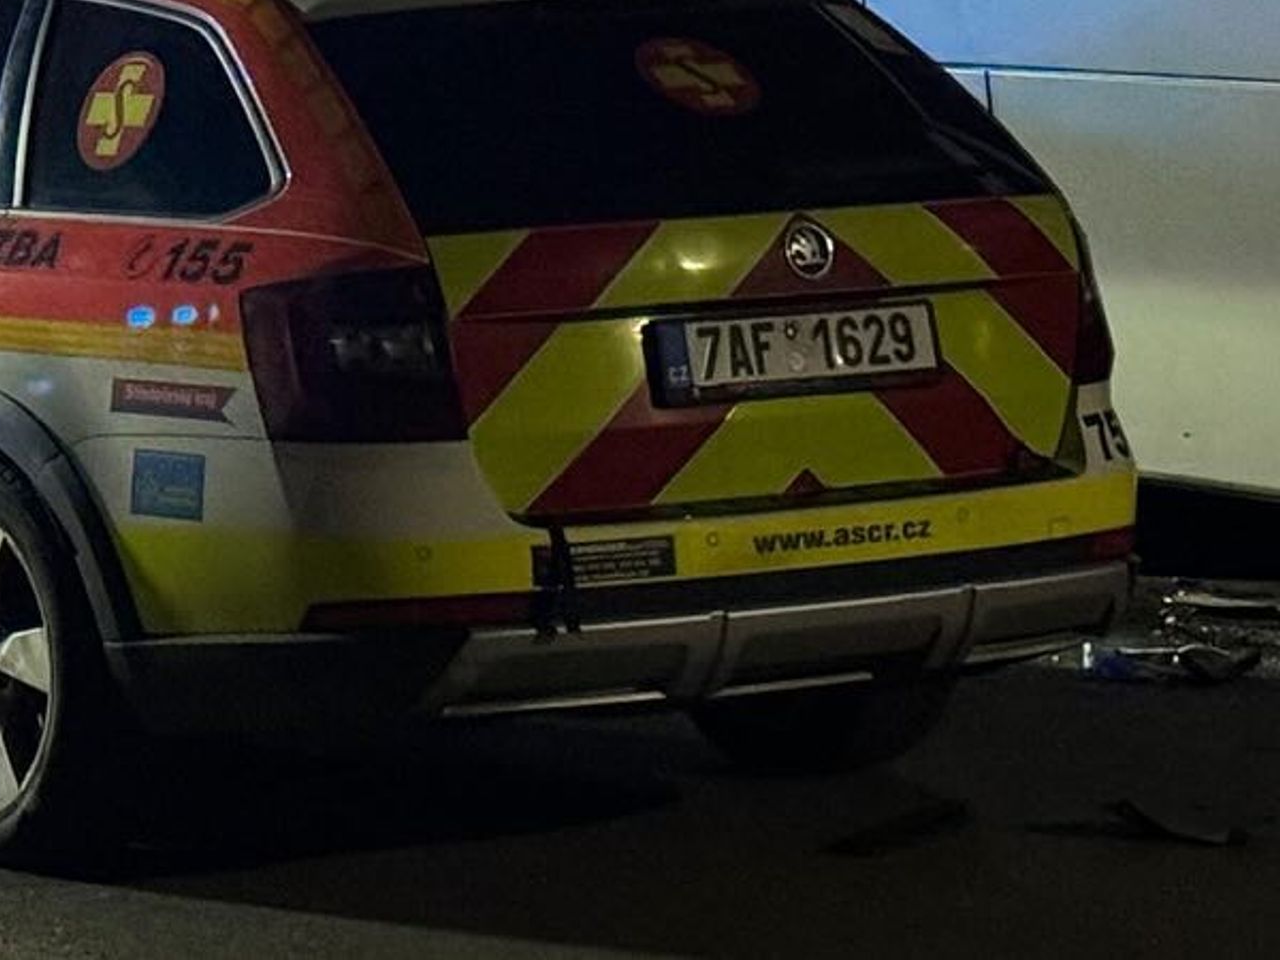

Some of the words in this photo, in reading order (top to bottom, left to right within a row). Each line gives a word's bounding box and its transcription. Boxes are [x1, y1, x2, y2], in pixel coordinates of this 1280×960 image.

[162, 238, 254, 285] 155
[696, 322, 774, 380] 7AF
[813, 311, 916, 371] 1629
[752, 517, 933, 555] www.ascr.cz
